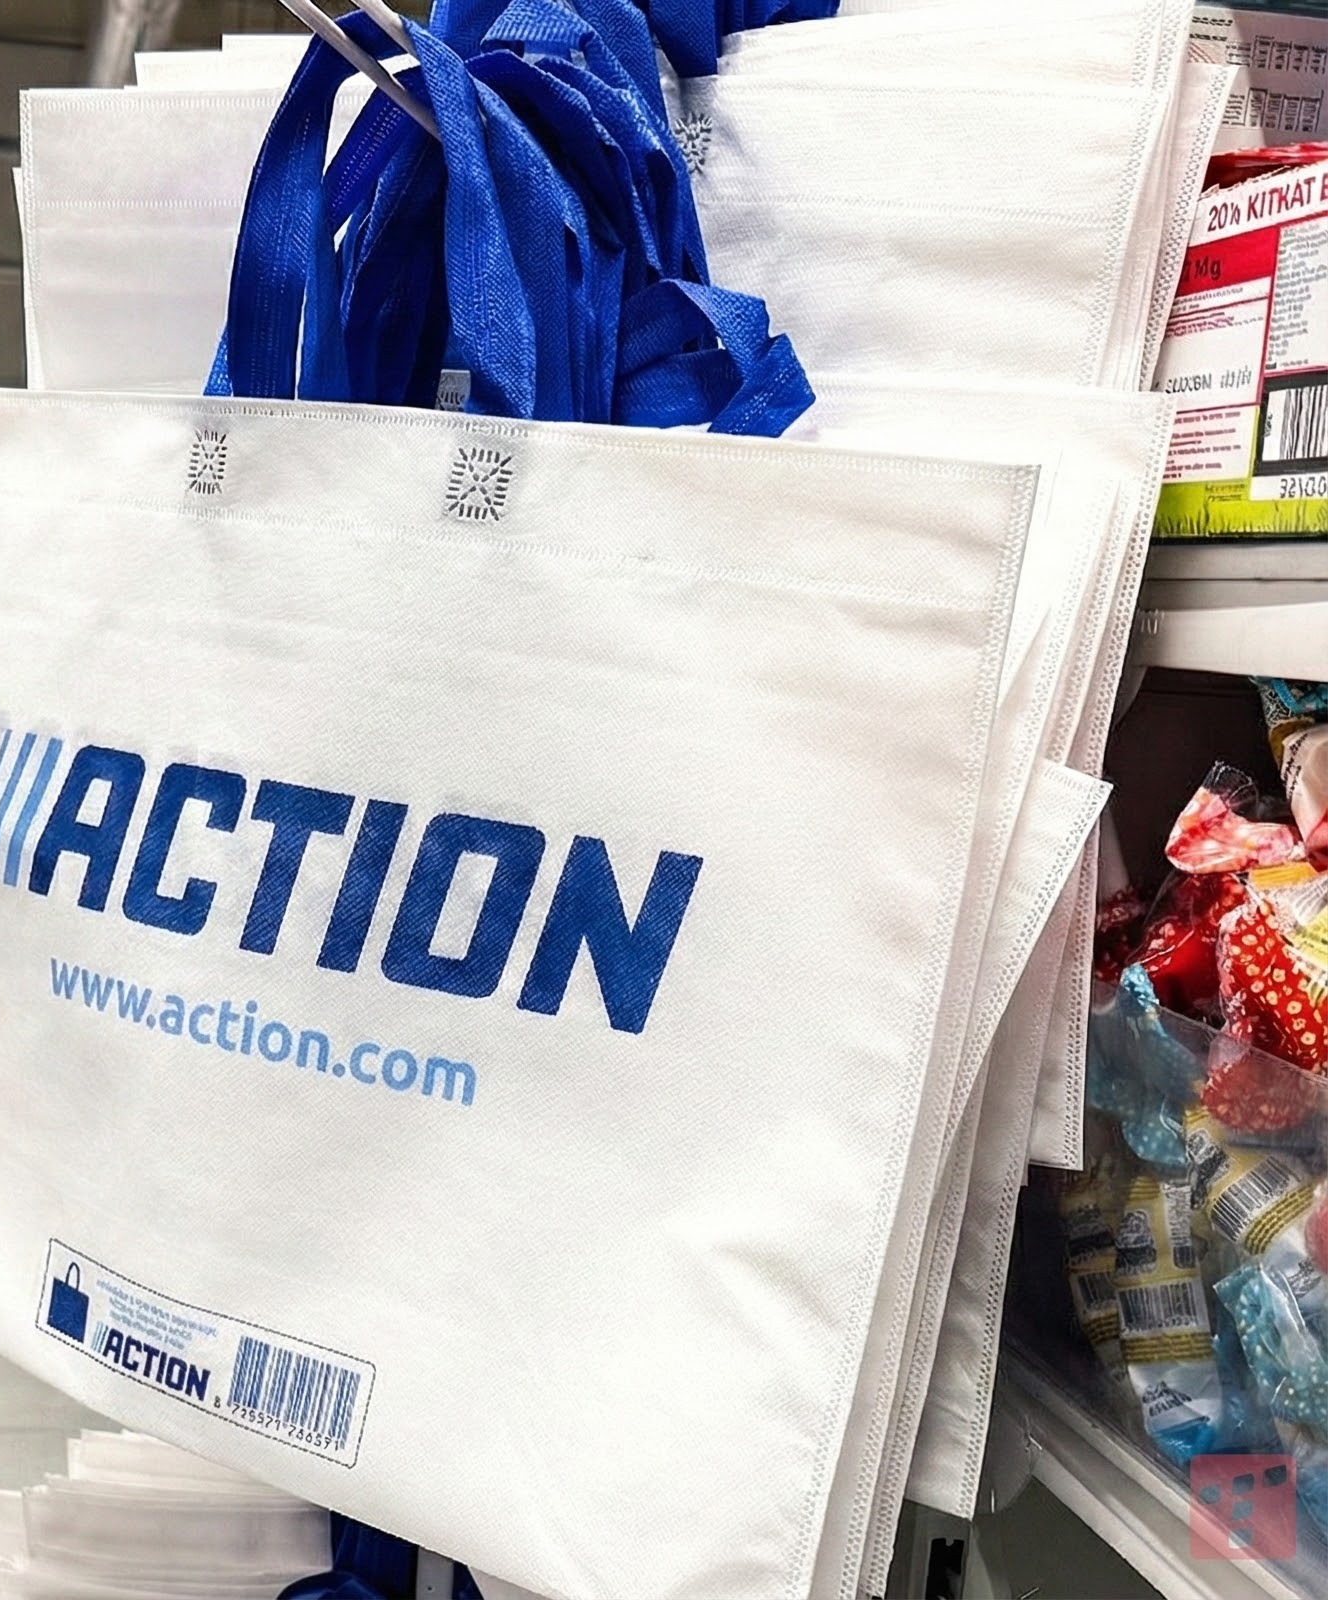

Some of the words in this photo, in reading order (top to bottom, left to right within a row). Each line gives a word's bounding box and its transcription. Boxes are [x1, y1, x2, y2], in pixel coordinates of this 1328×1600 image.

[1207, 201, 1242, 232] 20%
[1246, 175, 1317, 222] KITKAT
[27, 743, 703, 1036] ACTION
[49, 956, 478, 1106] www.action.com
[101, 1328, 211, 1401] ACTION
